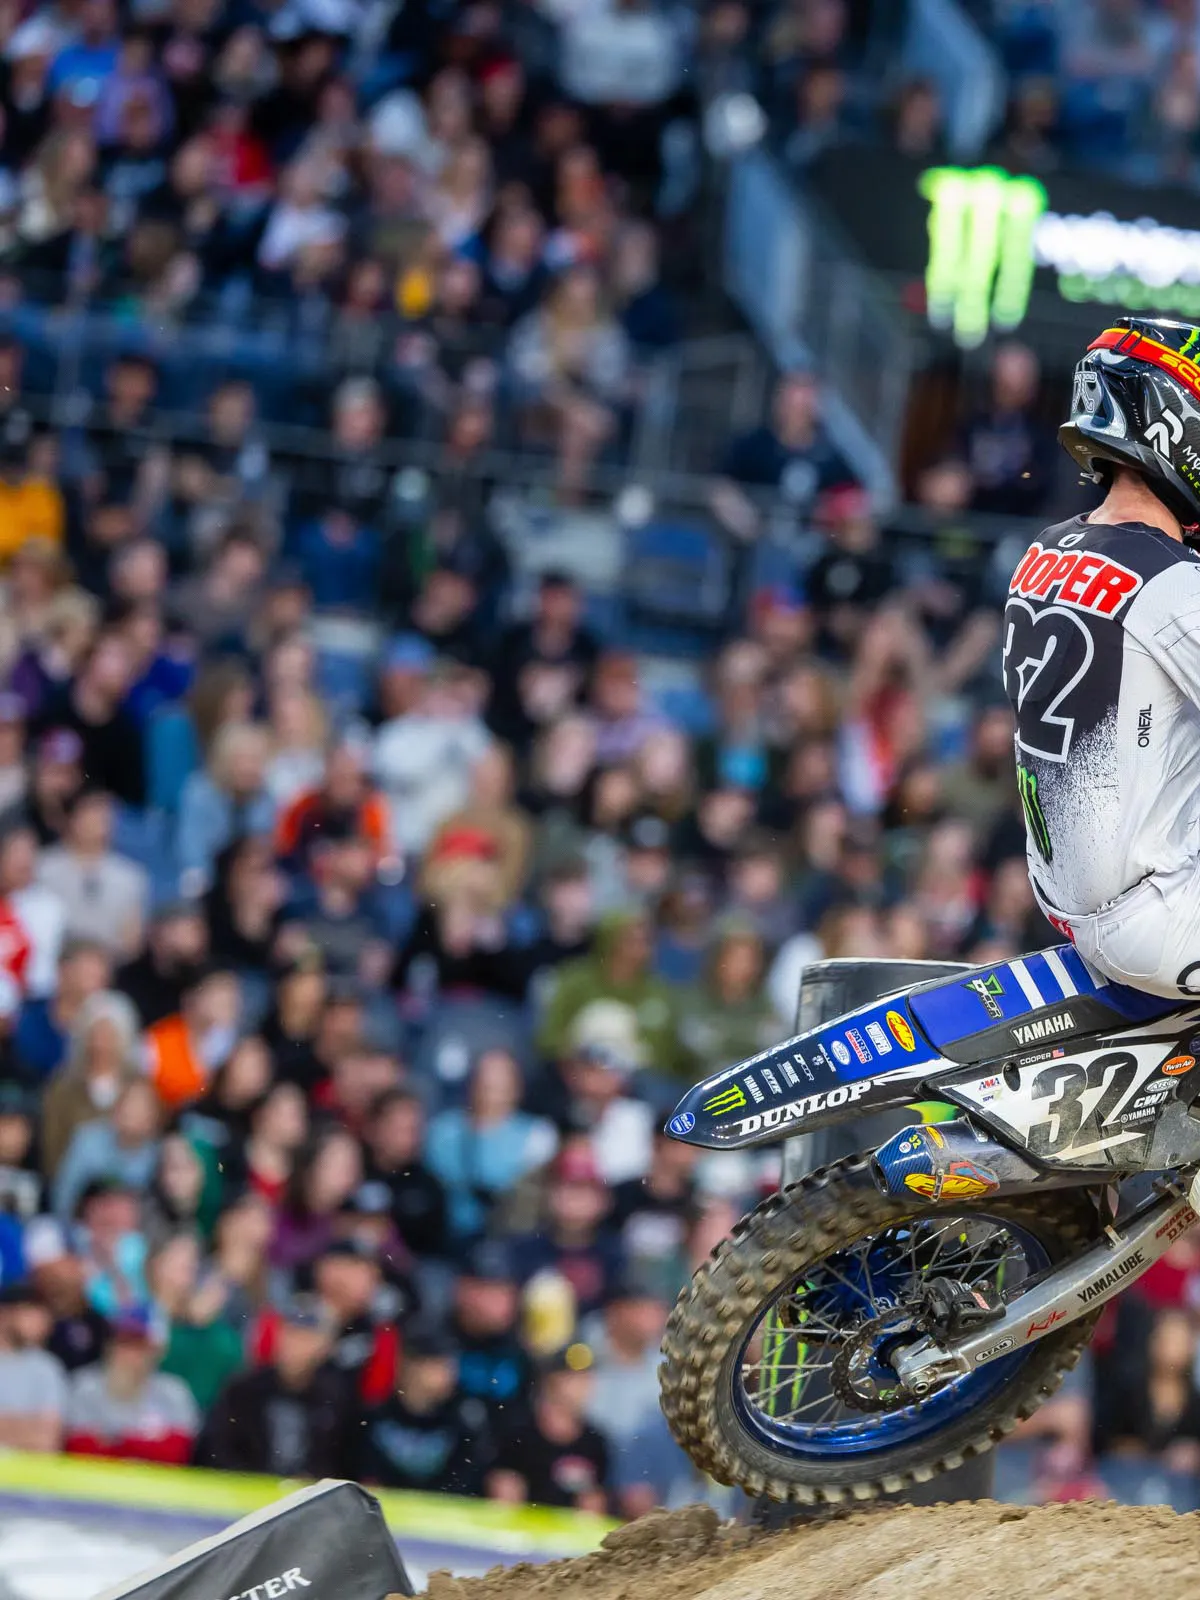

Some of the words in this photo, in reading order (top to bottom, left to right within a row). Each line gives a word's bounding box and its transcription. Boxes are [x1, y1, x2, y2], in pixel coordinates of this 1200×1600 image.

[1012, 1012, 1075, 1045] YAMAHA
[850, 1029, 872, 1061] PARTS
[1019, 1051, 1052, 1066] COOPER
[1165, 1063, 1181, 1072] Twin
[1181, 1059, 1193, 1068] Air
[743, 1075, 765, 1103] YAMAHA
[1026, 1051, 1138, 1155] 32
[739, 1080, 871, 1136] DUNLOP
[1128, 1106, 1156, 1120] YAMAHA
[908, 1134, 922, 1149] 32
[1077, 1249, 1145, 1303] YAMALUBE
[981, 1341, 1008, 1359] AFAM
